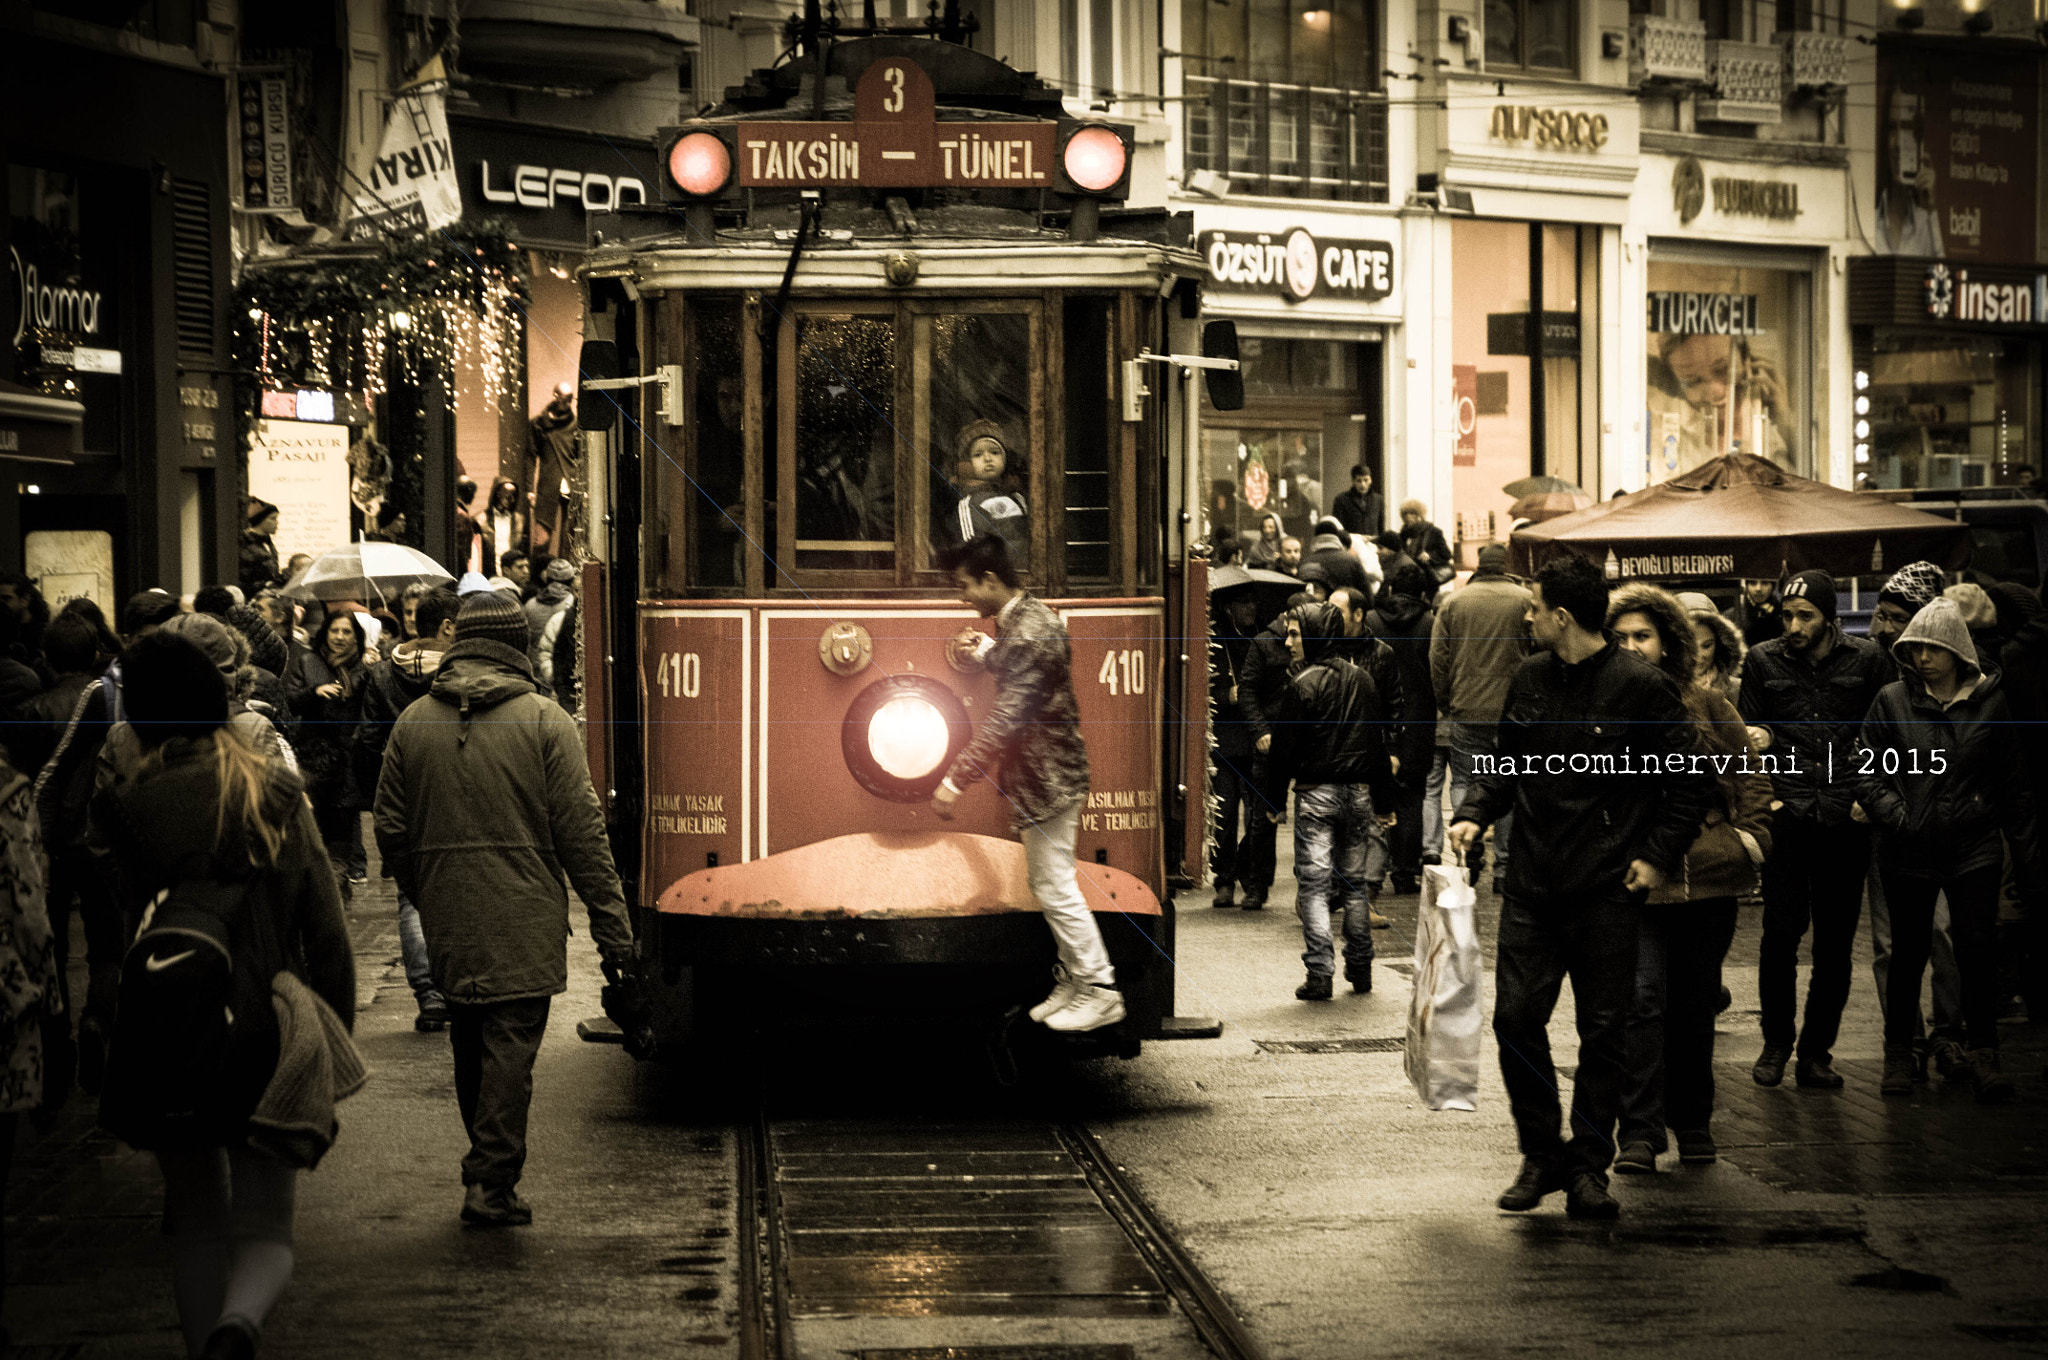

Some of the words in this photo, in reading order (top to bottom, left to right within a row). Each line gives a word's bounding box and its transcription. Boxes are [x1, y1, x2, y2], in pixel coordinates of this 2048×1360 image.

[883, 66, 906, 114] 3
[269, 137, 288, 205] SÜRÜCÜ
[746, 132, 860, 180] TAKSİM
[938, 132, 1046, 180] TÜNEL
[1711, 177, 1804, 222] TURKCELL
[1950, 205, 1981, 237] babil
[1209, 231, 1287, 286] ÖZSÜT
[1322, 246, 1391, 291] CAFE
[1654, 292, 1766, 336] TURKCELL
[1957, 269, 2033, 323] insan
[253, 434, 343, 449] AZNAVUR
[1621, 553, 1671, 577] BEYOĞLU
[1671, 553, 1735, 576] BELEDİYESİ
[656, 652, 701, 698] 410
[1098, 649, 1145, 696] 410
[685, 794, 724, 813] YASAK
[1081, 813, 1100, 832] VE
[1087, 791, 1136, 809] ASILMAK
